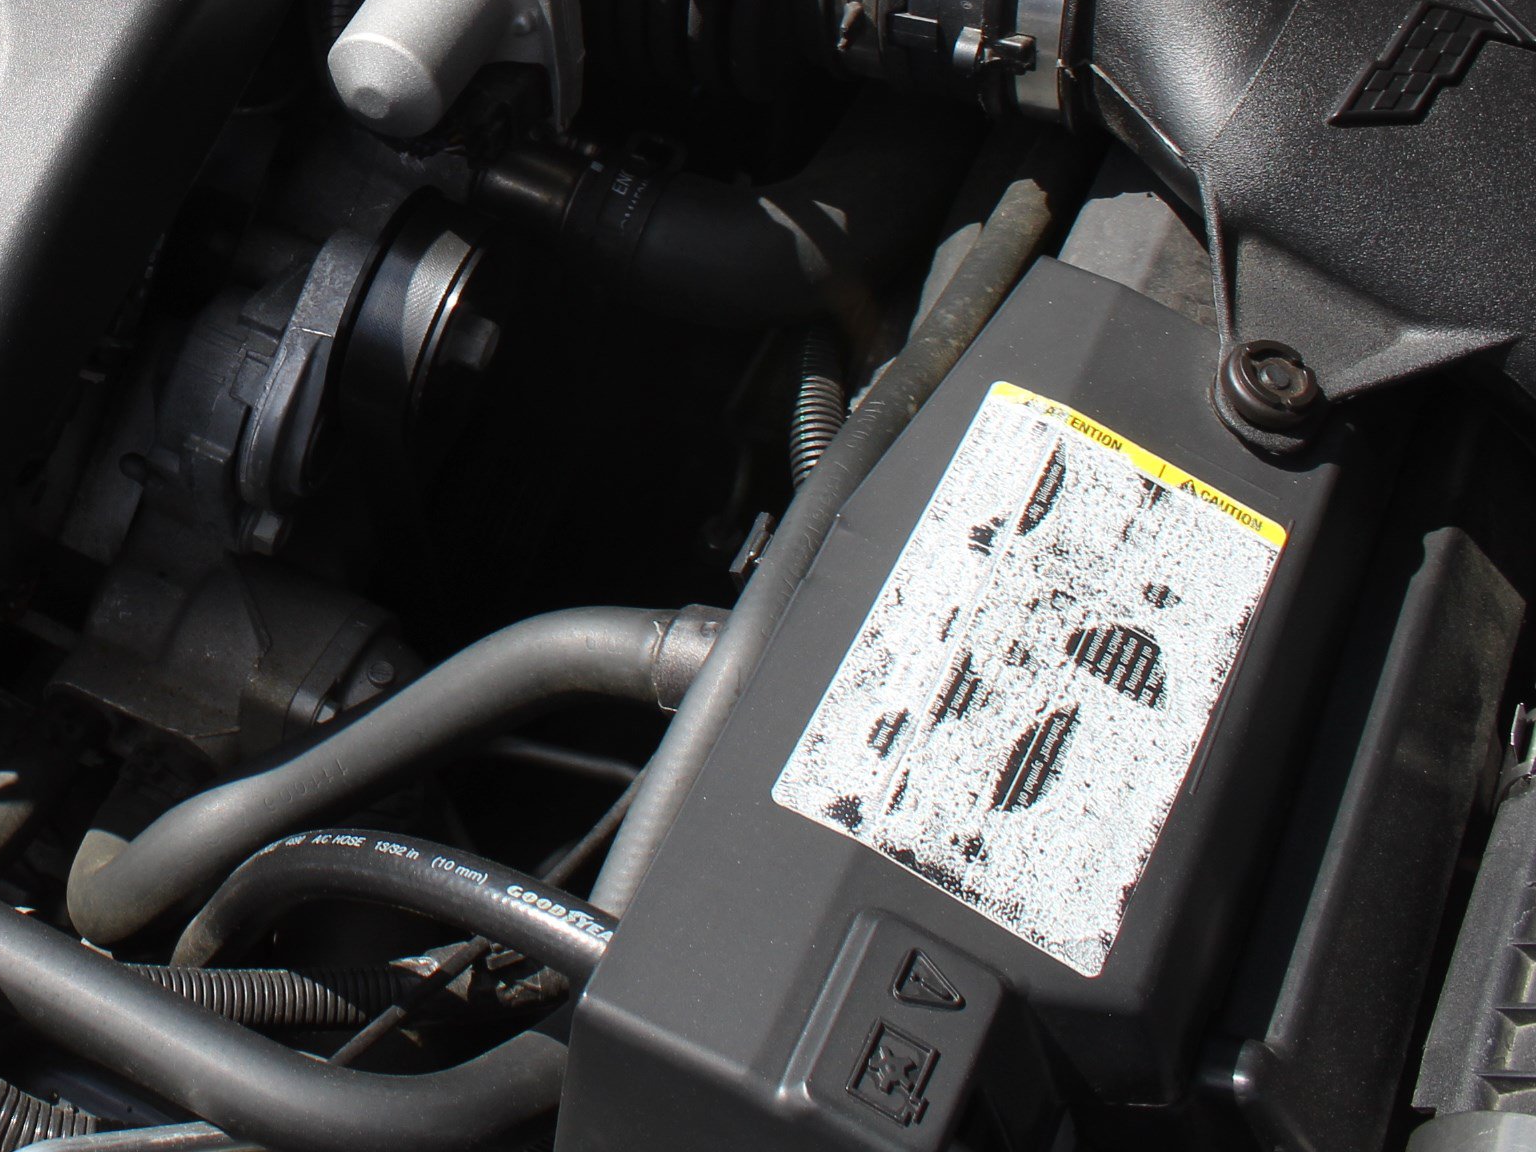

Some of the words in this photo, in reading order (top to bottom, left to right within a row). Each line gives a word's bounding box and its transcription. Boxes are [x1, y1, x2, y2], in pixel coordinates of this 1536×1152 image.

[1045, 405, 1122, 452] AENTION
[1200, 489, 1263, 531] CAUTION
[332, 834, 366, 847] HOSE
[431, 856, 454, 871] (10
[455, 864, 489, 885] mm)
[506, 884, 614, 941] GOODYEA
